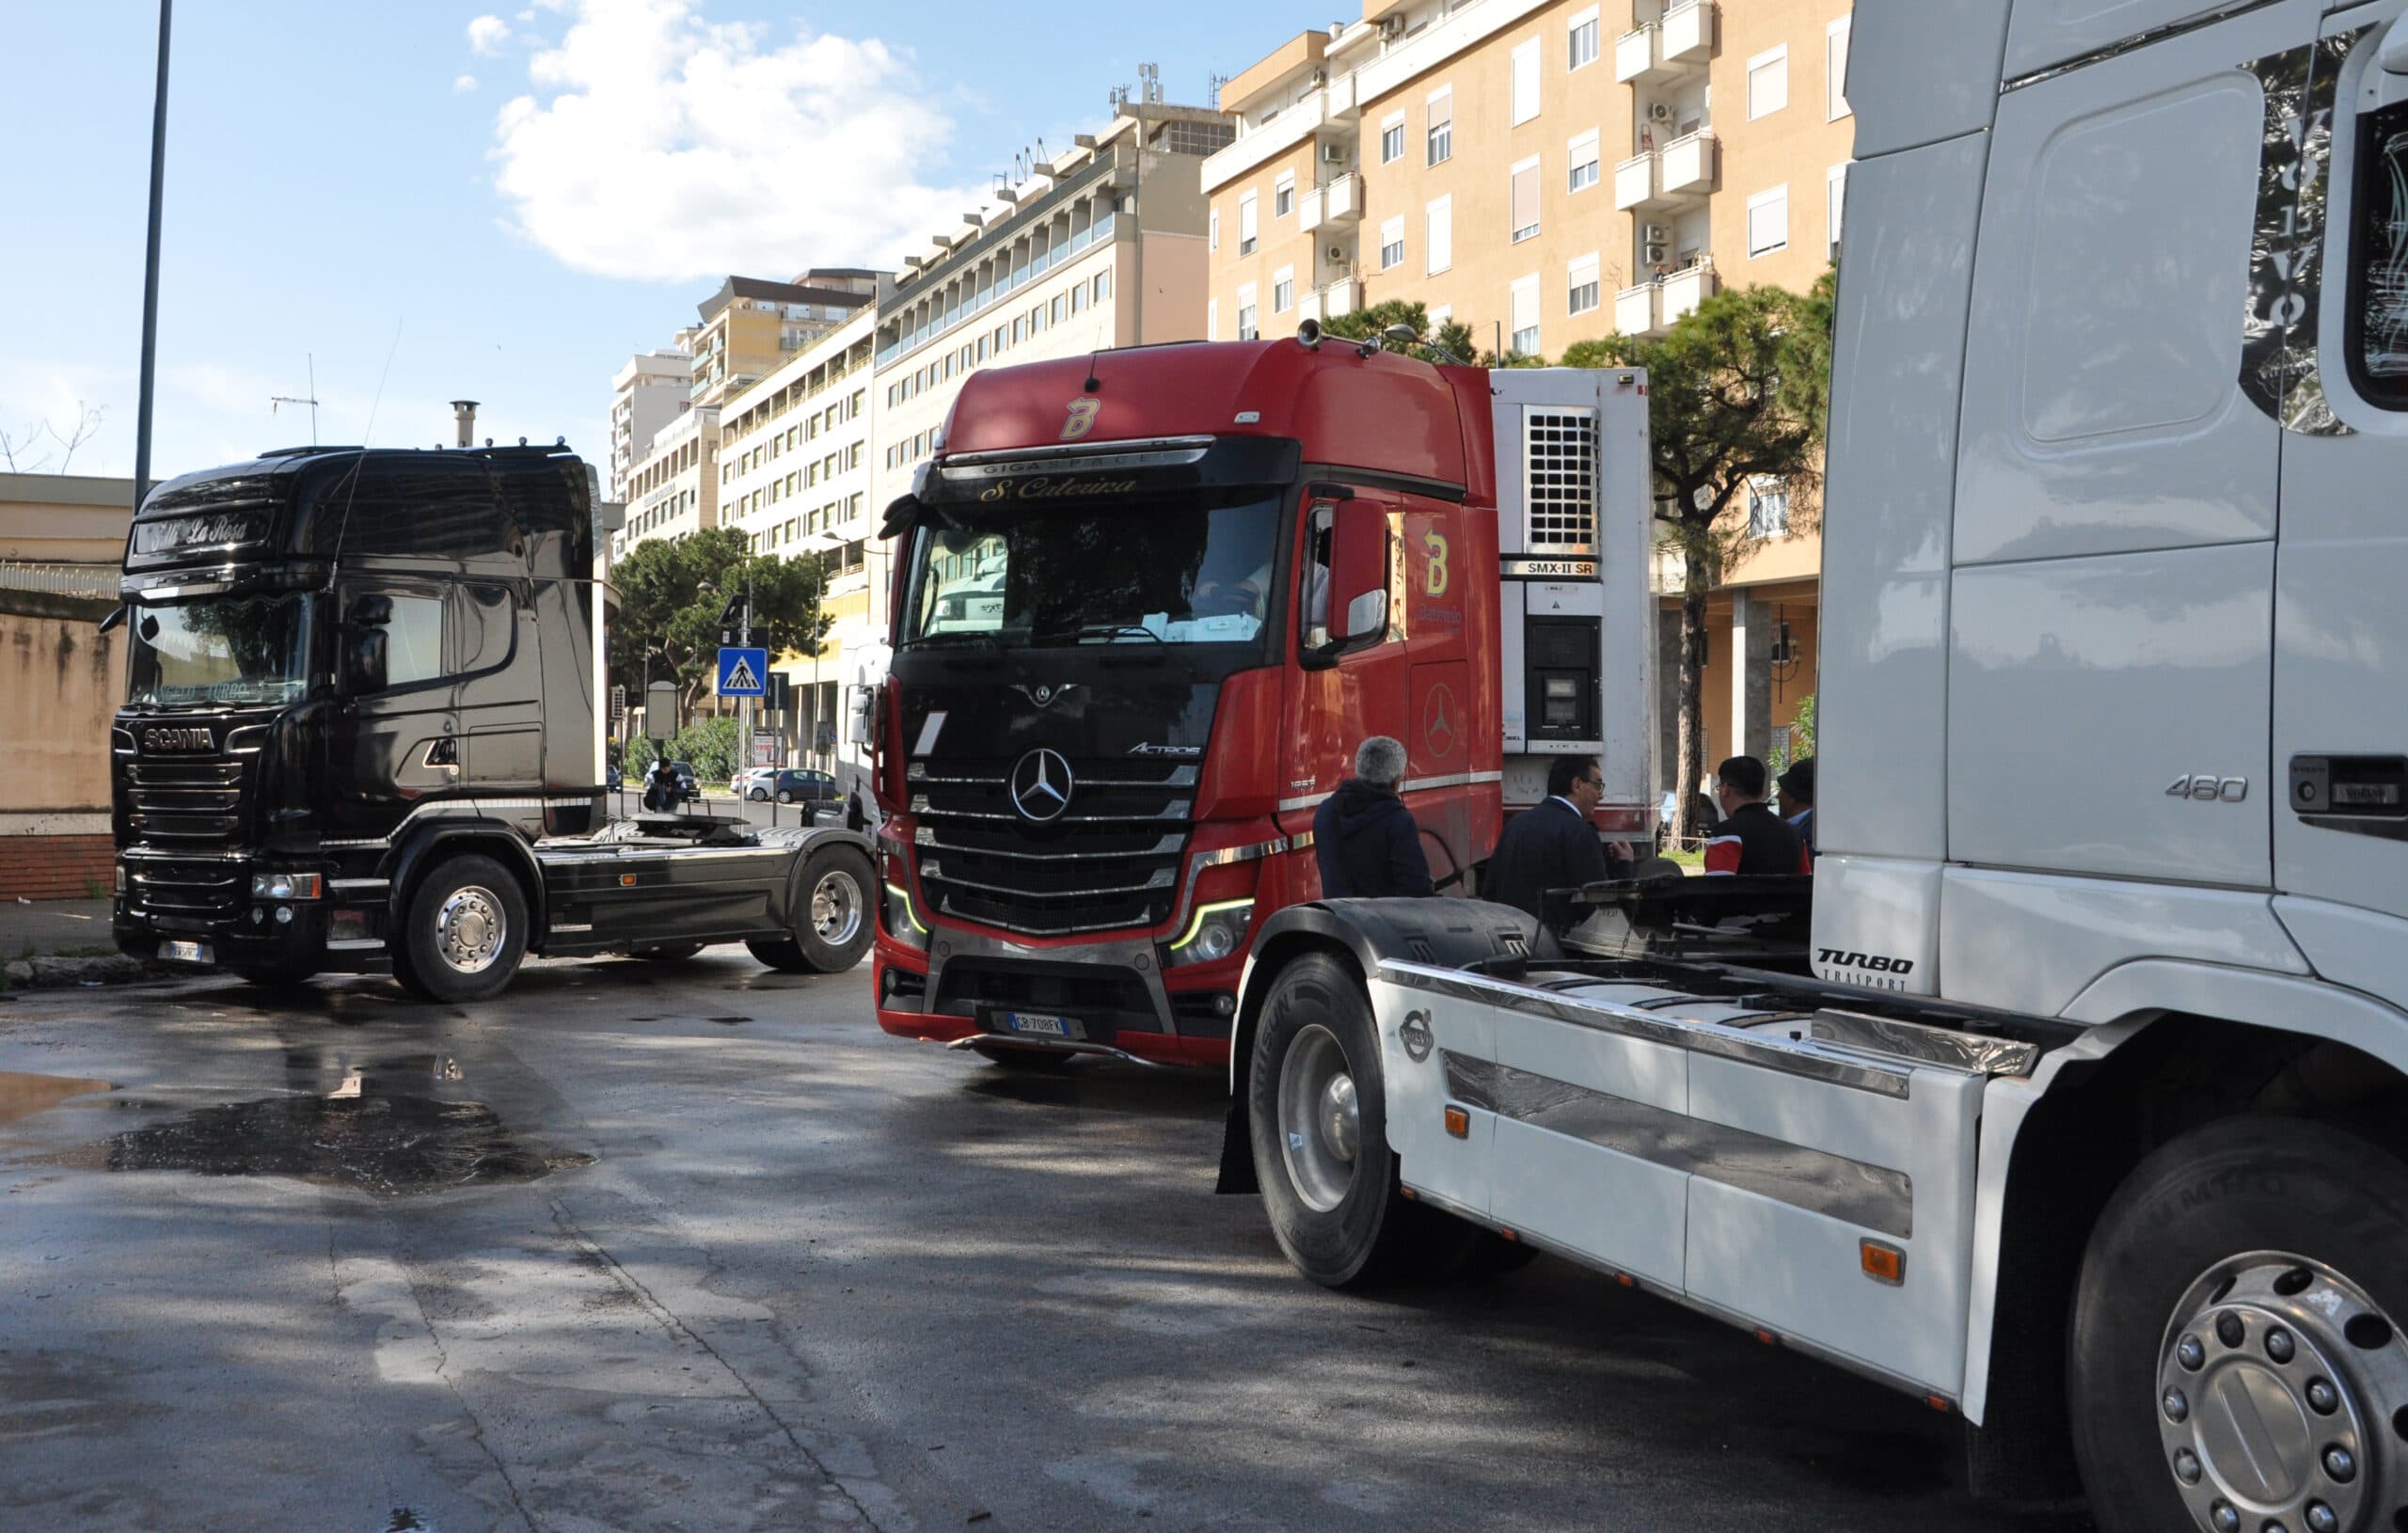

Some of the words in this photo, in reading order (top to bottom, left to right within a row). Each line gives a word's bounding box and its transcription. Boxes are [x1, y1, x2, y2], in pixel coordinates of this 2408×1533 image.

[2270, 107, 2331, 326] VOLVO
[1018, 478, 1137, 498] Caterina
[209, 515, 248, 543] Rosa
[1528, 562, 1572, 574] SMX-II
[1575, 563, 1593, 575] SR
[144, 728, 214, 751] SCANIA
[2165, 774, 2248, 802] 460
[1817, 948, 1915, 974] TURBO
[1824, 969, 1906, 992] TRASPORT
